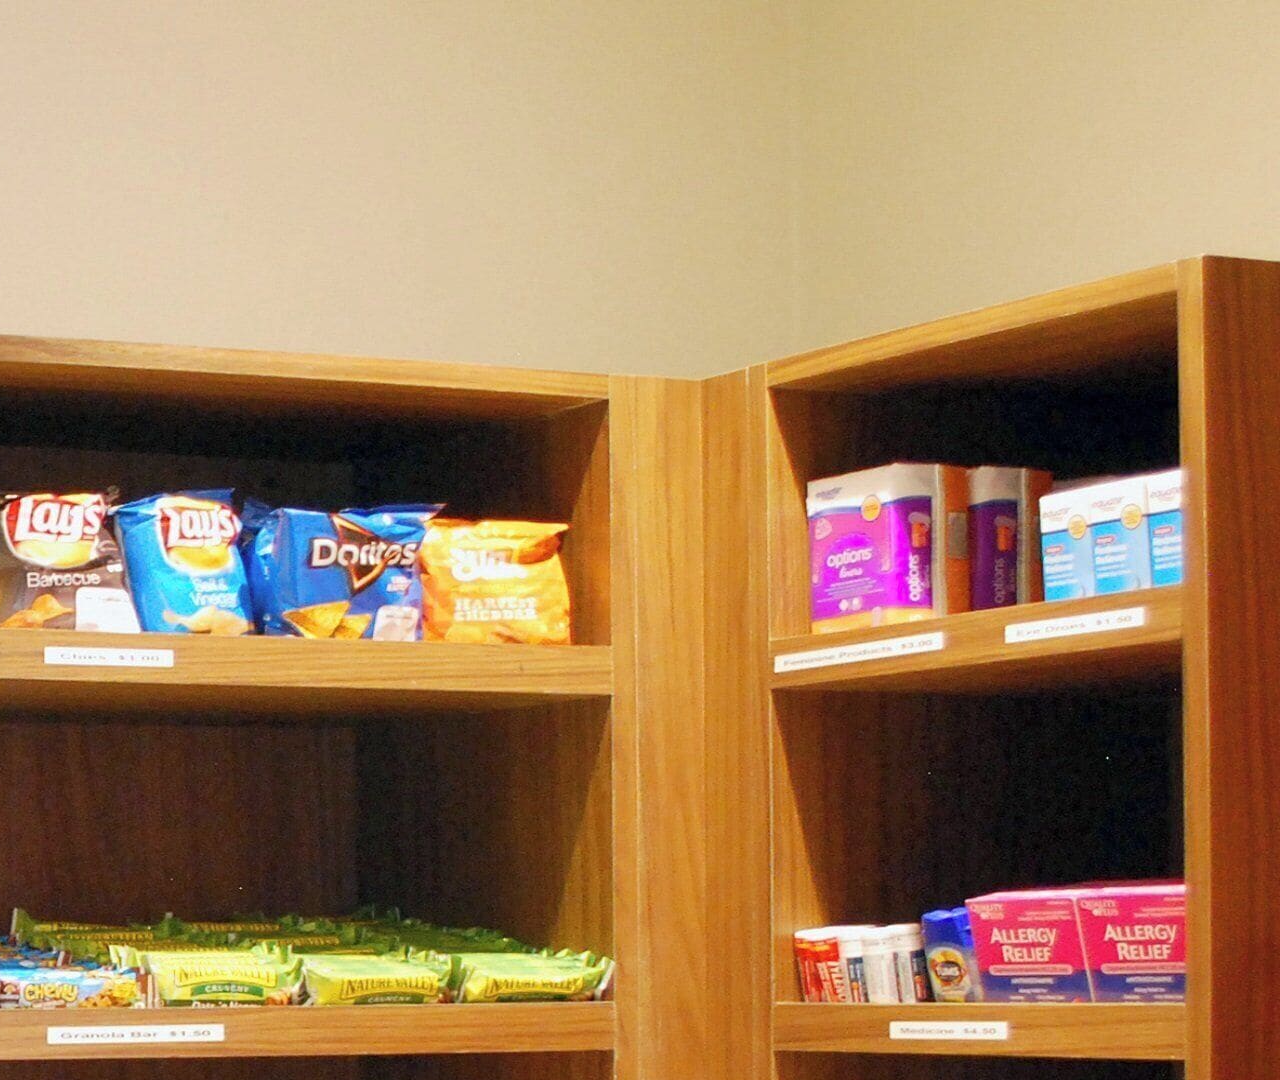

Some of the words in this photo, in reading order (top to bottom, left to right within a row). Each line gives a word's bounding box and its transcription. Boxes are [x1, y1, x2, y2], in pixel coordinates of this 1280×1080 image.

[309, 537, 419, 569] Doritos
[826, 547, 874, 569] options
[26, 571, 102, 590] Barbecue
[908, 554, 923, 602] options
[989, 926, 1057, 946] ALLERGY
[1103, 923, 1178, 944] ALLERGY
[1001, 944, 1053, 963] RELIEF
[1115, 942, 1173, 961] RELIEF
[345, 977, 391, 994] NATURE
[393, 976, 435, 992] VALLEY
[60, 1029, 126, 1040] Granola
[130, 1029, 159, 1039] Bar
[168, 1028, 212, 1038] $1.50
[899, 1026, 956, 1035] Medicine
[962, 1026, 999, 1036] $4.50
